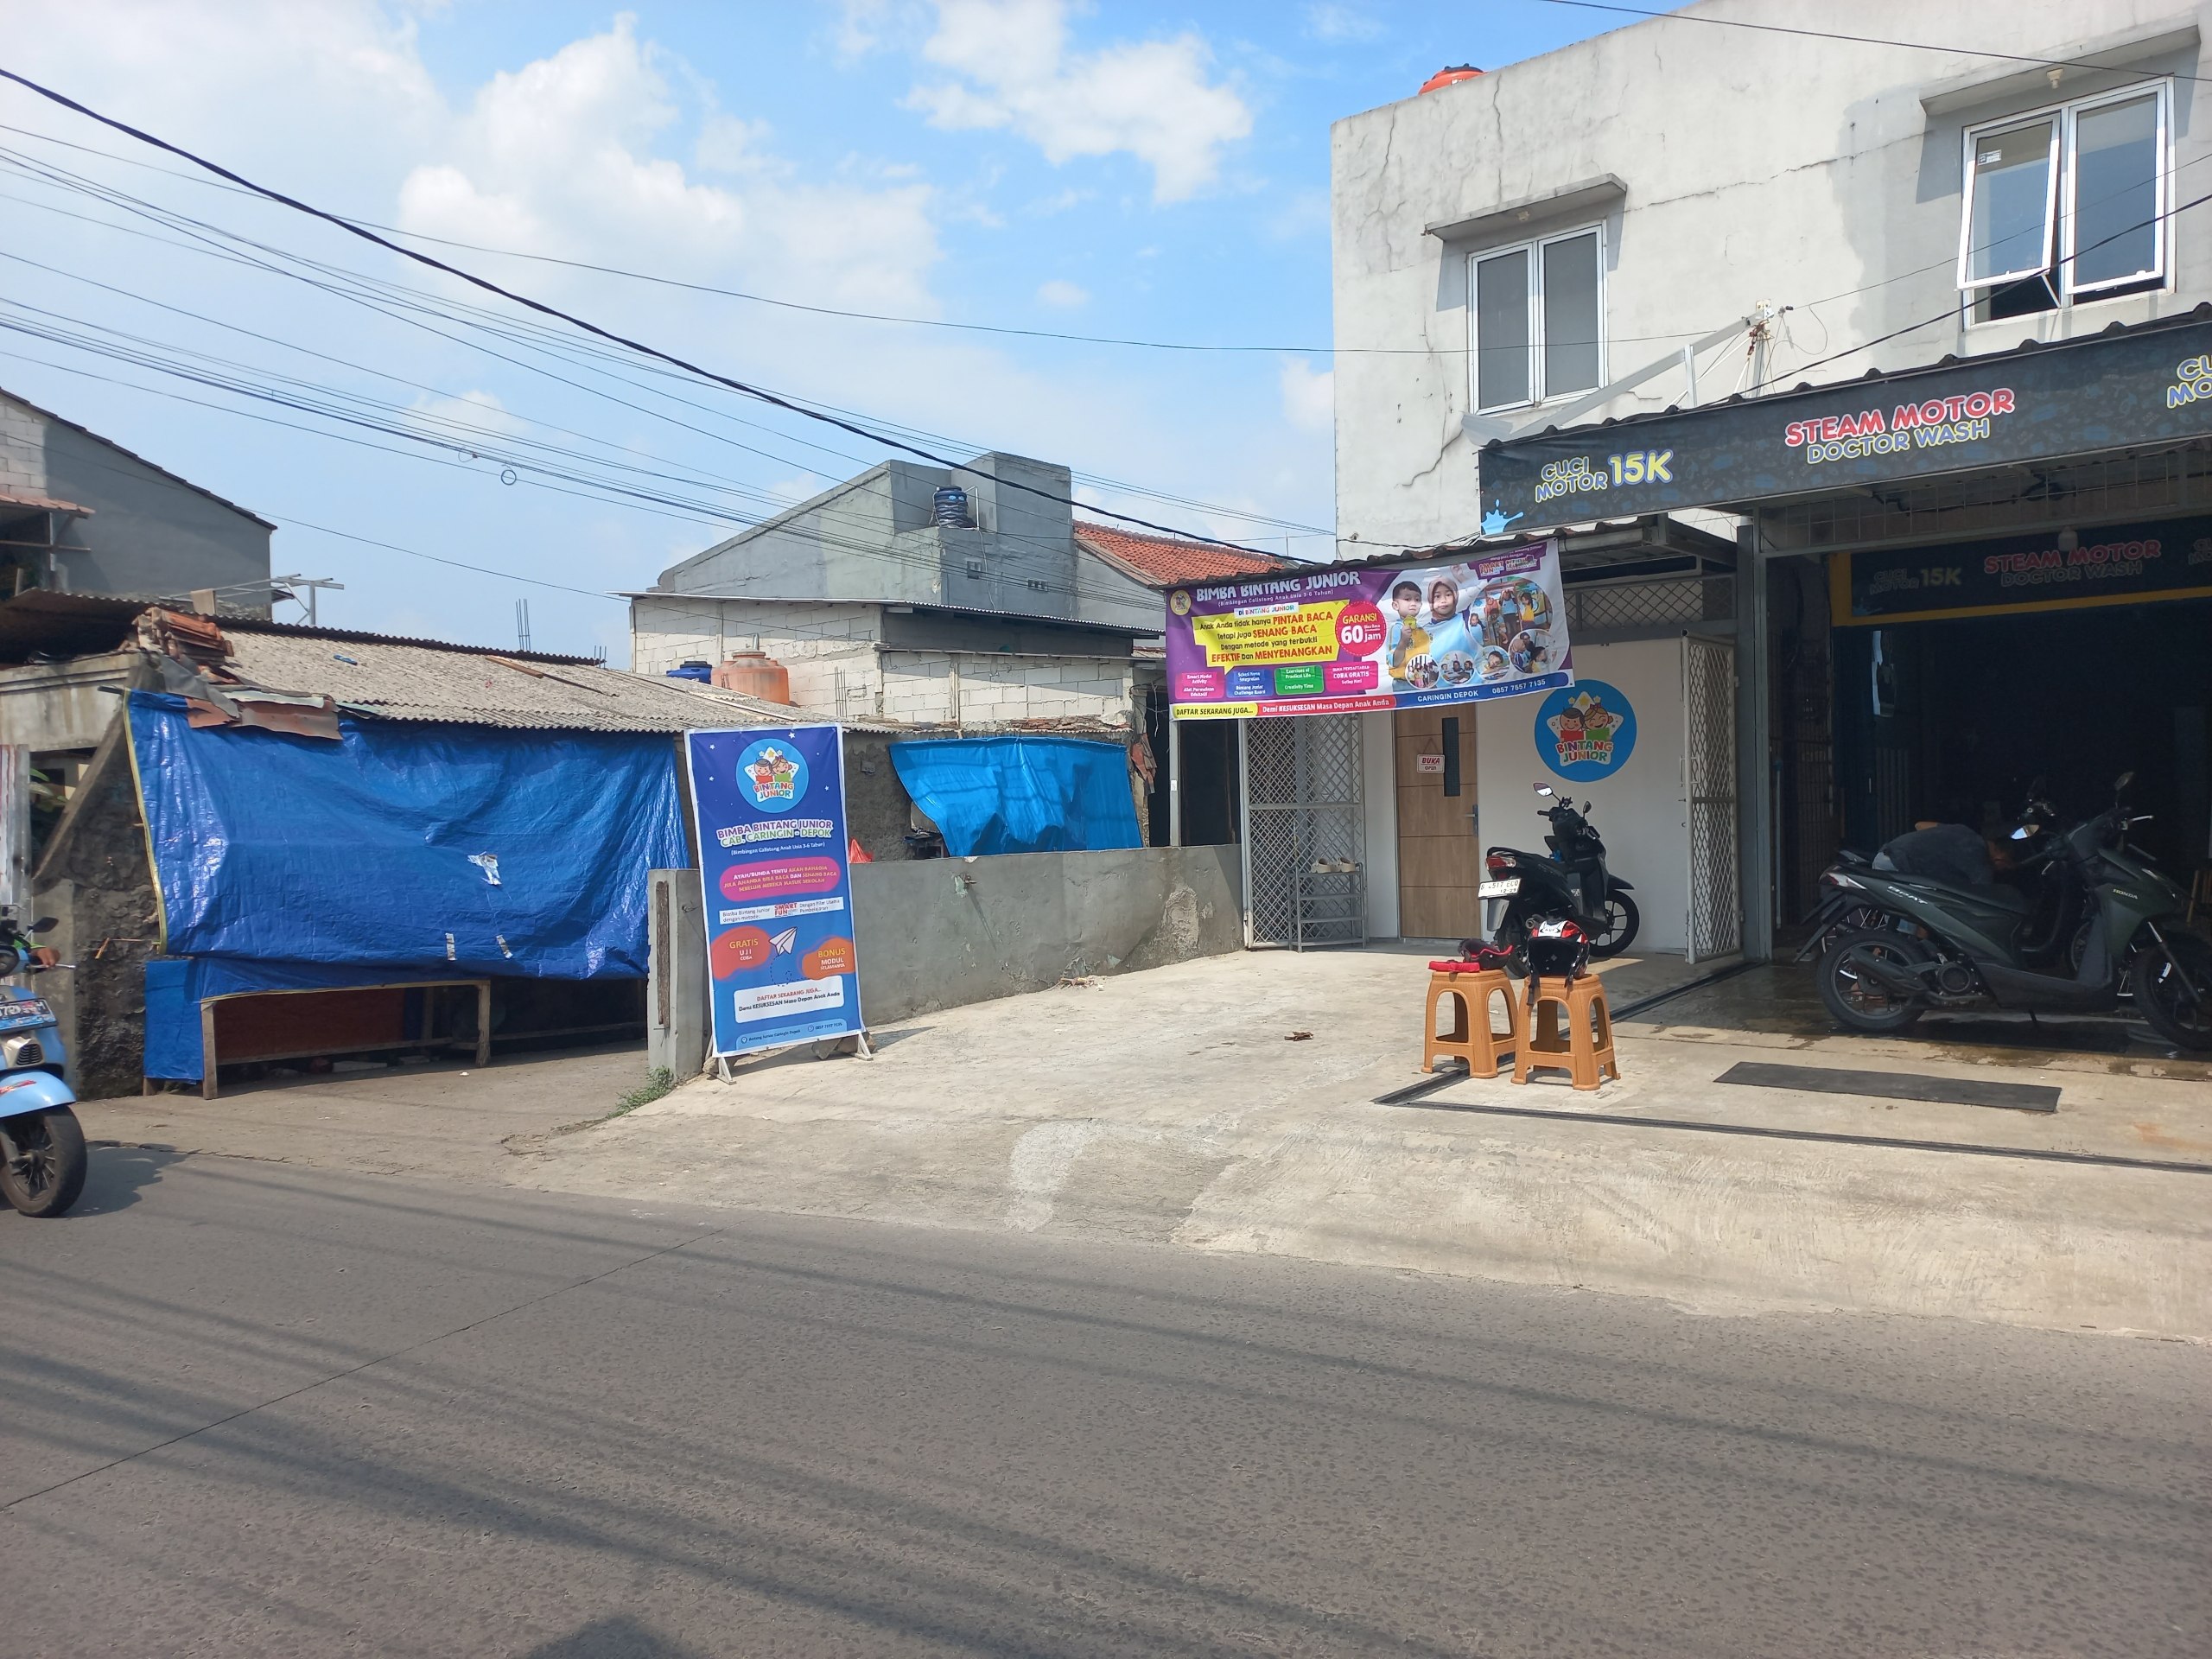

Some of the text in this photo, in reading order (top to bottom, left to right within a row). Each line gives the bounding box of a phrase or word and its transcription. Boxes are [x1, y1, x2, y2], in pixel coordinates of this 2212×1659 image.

[1785, 388, 2015, 447] STEAM MOTOR
[1807, 417, 1990, 465] DOCTOR WASH
[1541, 455, 1590, 481] CUCI
[1608, 449, 1674, 487] 15K
[1535, 471, 1608, 503] MOTOR
[1984, 539, 2162, 574] STEAM MOTOR
[1920, 567, 1961, 587] 15K
[2000, 561, 2143, 588] DOCTOR WASH
[1196, 571, 1361, 602] BIMBA BINTANG JUNIOR
[1869, 577, 1919, 595] MOTOR
[1234, 620, 1250, 628] tidak
[1251, 618, 1271, 626] hanya
[1273, 613, 1304, 625] PINTAR
[1306, 611, 1333, 622] BACA
[1342, 613, 1377, 625] GARANSI
[1253, 626, 1288, 639] SENANG
[1291, 625, 1317, 635] BACA
[1341, 624, 1363, 645] 60
[1220, 643, 1243, 652] Dengan
[1244, 640, 1269, 649] metode
[1289, 636, 1318, 645] terbukti
[1211, 652, 1241, 663] EFEKTIF
[1255, 645, 1332, 660] MENYENANGKAN
[1491, 685, 1509, 695] 0857
[1529, 678, 1546, 688] 7135
[1417, 690, 1478, 702] CARINGIN DEPOK
[1333, 702, 1354, 710] Depan
[1556, 740, 1613, 753] BINTANG
[1563, 750, 1608, 762] JUNIOR
[753, 781, 794, 792] BINTANG
[759, 790, 791, 799] JUNIOR
[717, 819, 832, 839] BIMBA BINTANG JUNIOR
[721, 835, 746, 847] CAB.
[747, 830, 793, 842] CARINGIN
[801, 829, 831, 837] DEPOK
[774, 902, 798, 911] SMART
[729, 938, 759, 949] GRATIS
[817, 947, 846, 958] BONUS
[821, 957, 844, 966] MODUL
[757, 993, 777, 1001] DAFTAR
[778, 990, 804, 999] SEKARANG
[753, 1000, 783, 1009] KESUKSESAN
